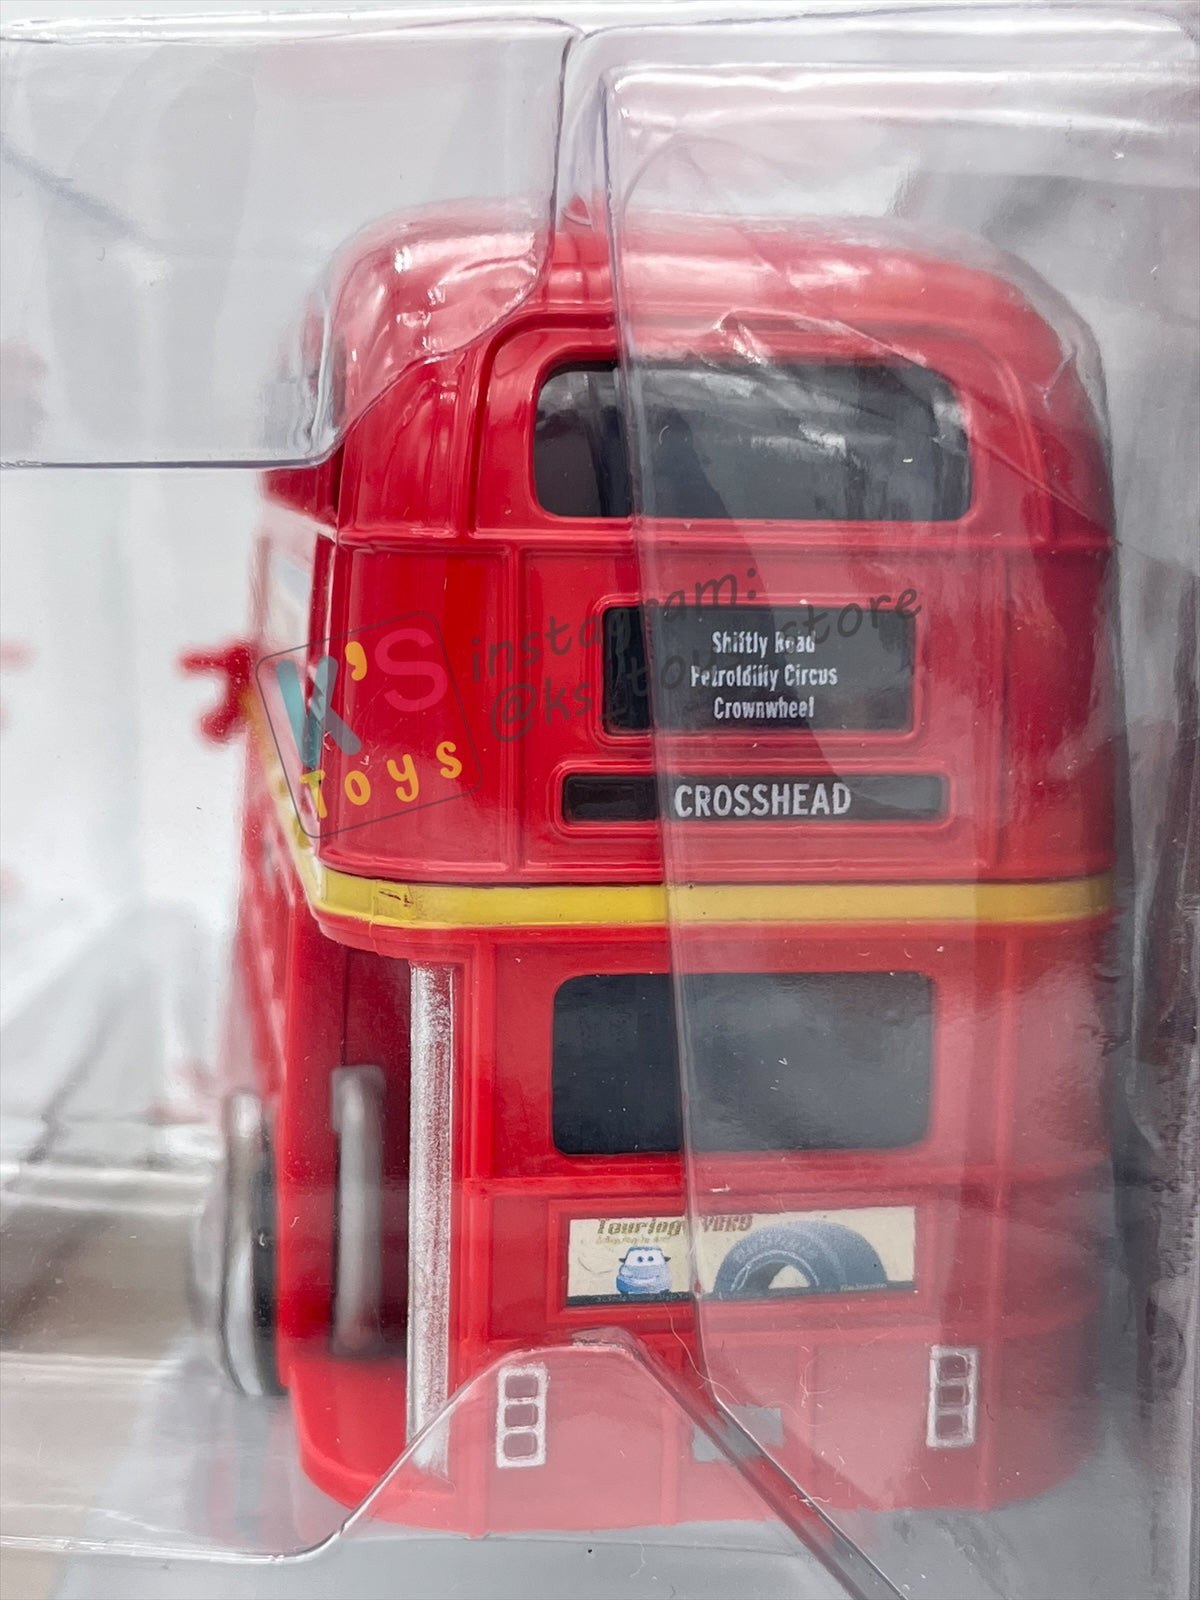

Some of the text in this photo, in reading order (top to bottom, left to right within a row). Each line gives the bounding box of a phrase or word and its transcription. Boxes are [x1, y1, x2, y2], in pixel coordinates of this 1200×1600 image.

[711, 630, 817, 659] Shiftly Road
[784, 663, 839, 687] Circus
[713, 695, 815, 720] Crownwheel
[673, 781, 852, 819] CROSSHEAD
